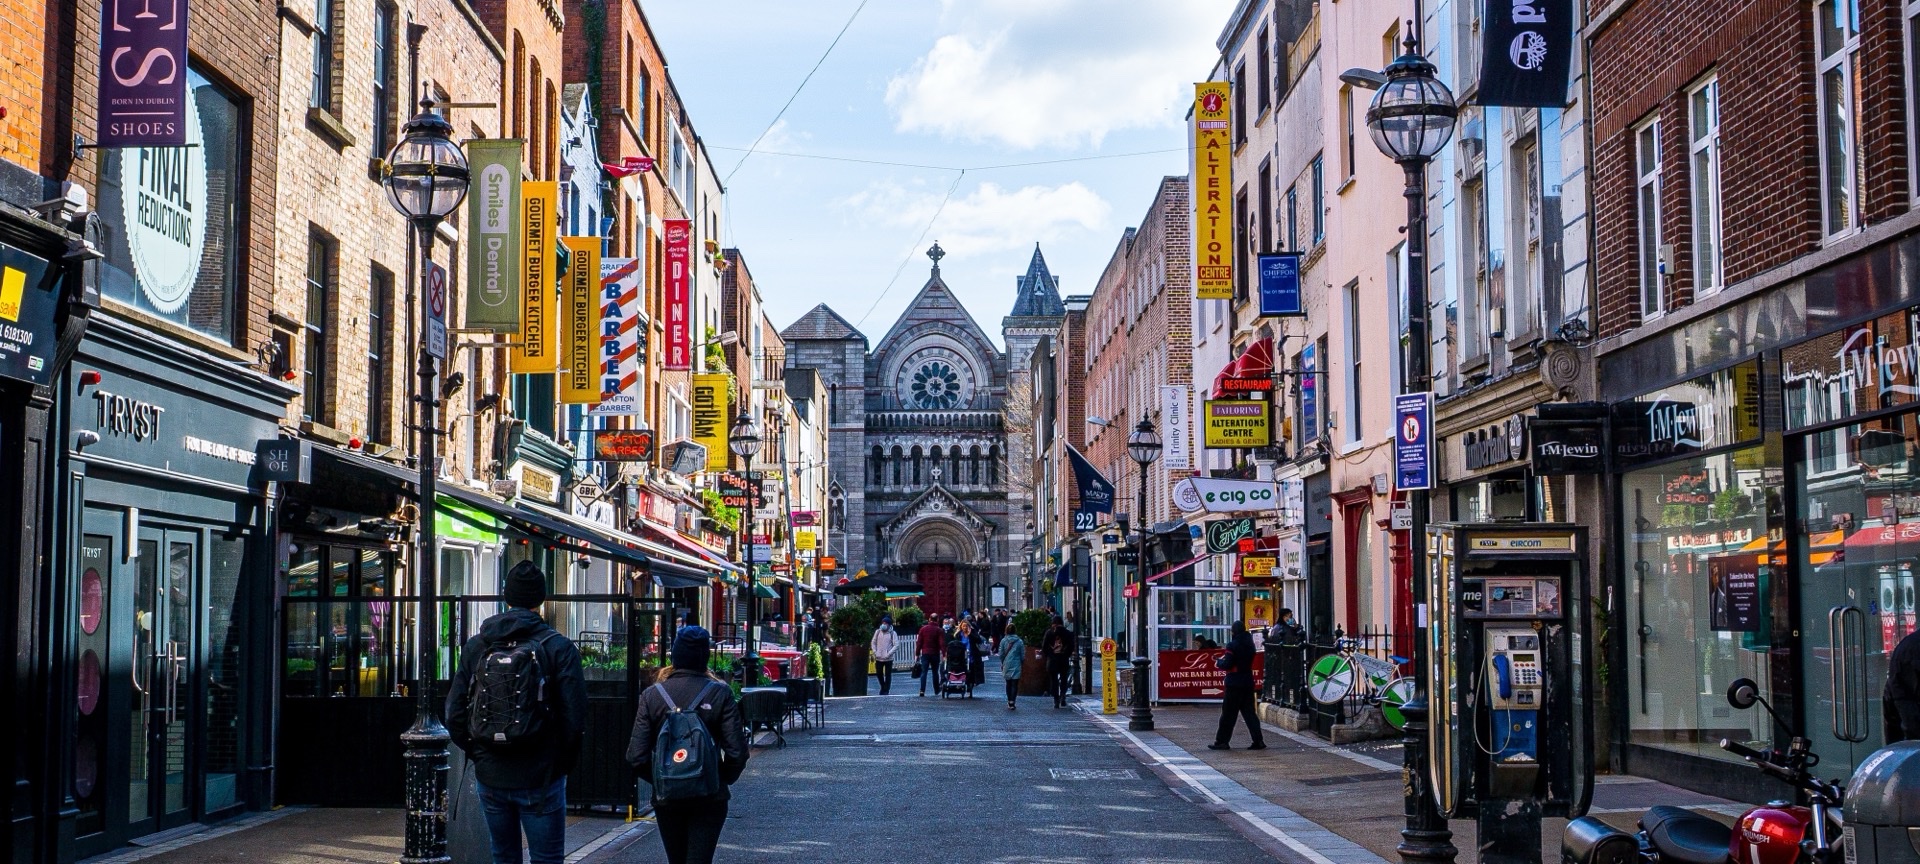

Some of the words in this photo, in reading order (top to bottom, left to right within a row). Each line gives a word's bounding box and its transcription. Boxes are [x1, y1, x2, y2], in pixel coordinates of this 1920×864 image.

[110, 122, 175, 136] SHOES
[138, 147, 192, 213] FINAL
[487, 173, 503, 228] Smiles
[1207, 138, 1221, 264] ALTERATION
[138, 191, 192, 248] REDUCTIONS
[529, 197, 541, 254] GOURMET
[486, 237, 502, 294] Dental
[576, 250, 587, 298] GOURMET
[1200, 267, 1230, 278] CENTRE
[528, 257, 540, 302] BURGER
[576, 302, 587, 343] BURGER
[672, 261, 683, 365] DINER
[4, 325, 33, 346] 6181300
[528, 306, 540, 357] KITCHEN
[605, 283, 623, 395] BARBER
[575, 345, 587, 390] KITCHEN
[1224, 379, 1272, 390] RESTAURANT
[93, 389, 165, 443] TRYST
[695, 386, 721, 438] GOTHAM
[1170, 402, 1179, 426] Clinic
[1216, 406, 1260, 415] TAILORING
[1211, 419, 1265, 428] ALTERATIONS
[1223, 429, 1254, 437] CENTRE
[599, 435, 649, 444] GRAFTON
[601, 446, 646, 455] BARBER
[1171, 428, 1180, 455] Trinity
[579, 486, 597, 496] GBK
[1205, 491, 1216, 503] e
[1219, 490, 1246, 504] cig
[1249, 488, 1272, 500] co
[1076, 512, 1094, 530] 22
[83, 546, 102, 558] TRYST
[1180, 652, 1209, 670] La
[1742, 829, 1770, 843] TRIUMPH
